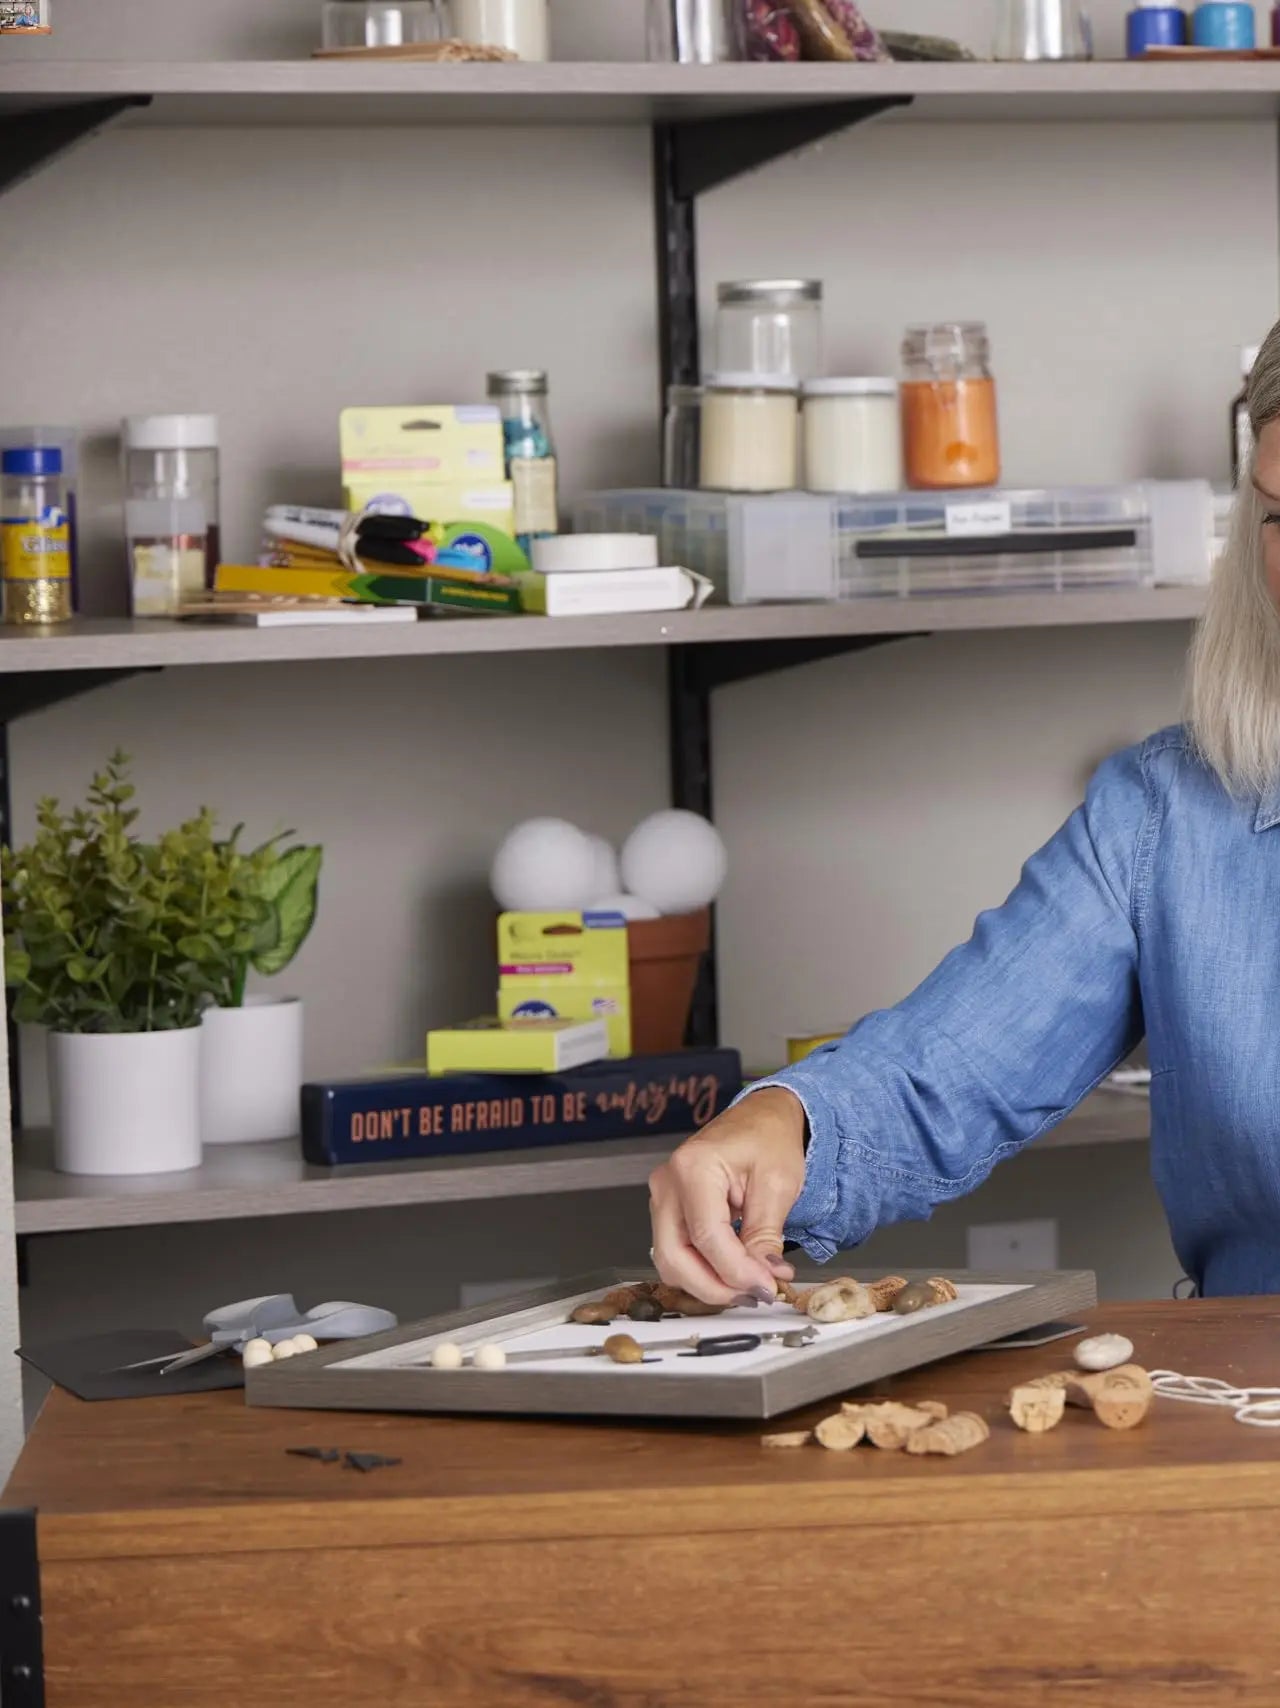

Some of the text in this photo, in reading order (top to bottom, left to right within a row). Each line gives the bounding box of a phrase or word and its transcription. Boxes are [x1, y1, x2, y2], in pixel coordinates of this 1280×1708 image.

[350, 1074, 720, 1143] DON'T BE AFRAID TO BE amazing
